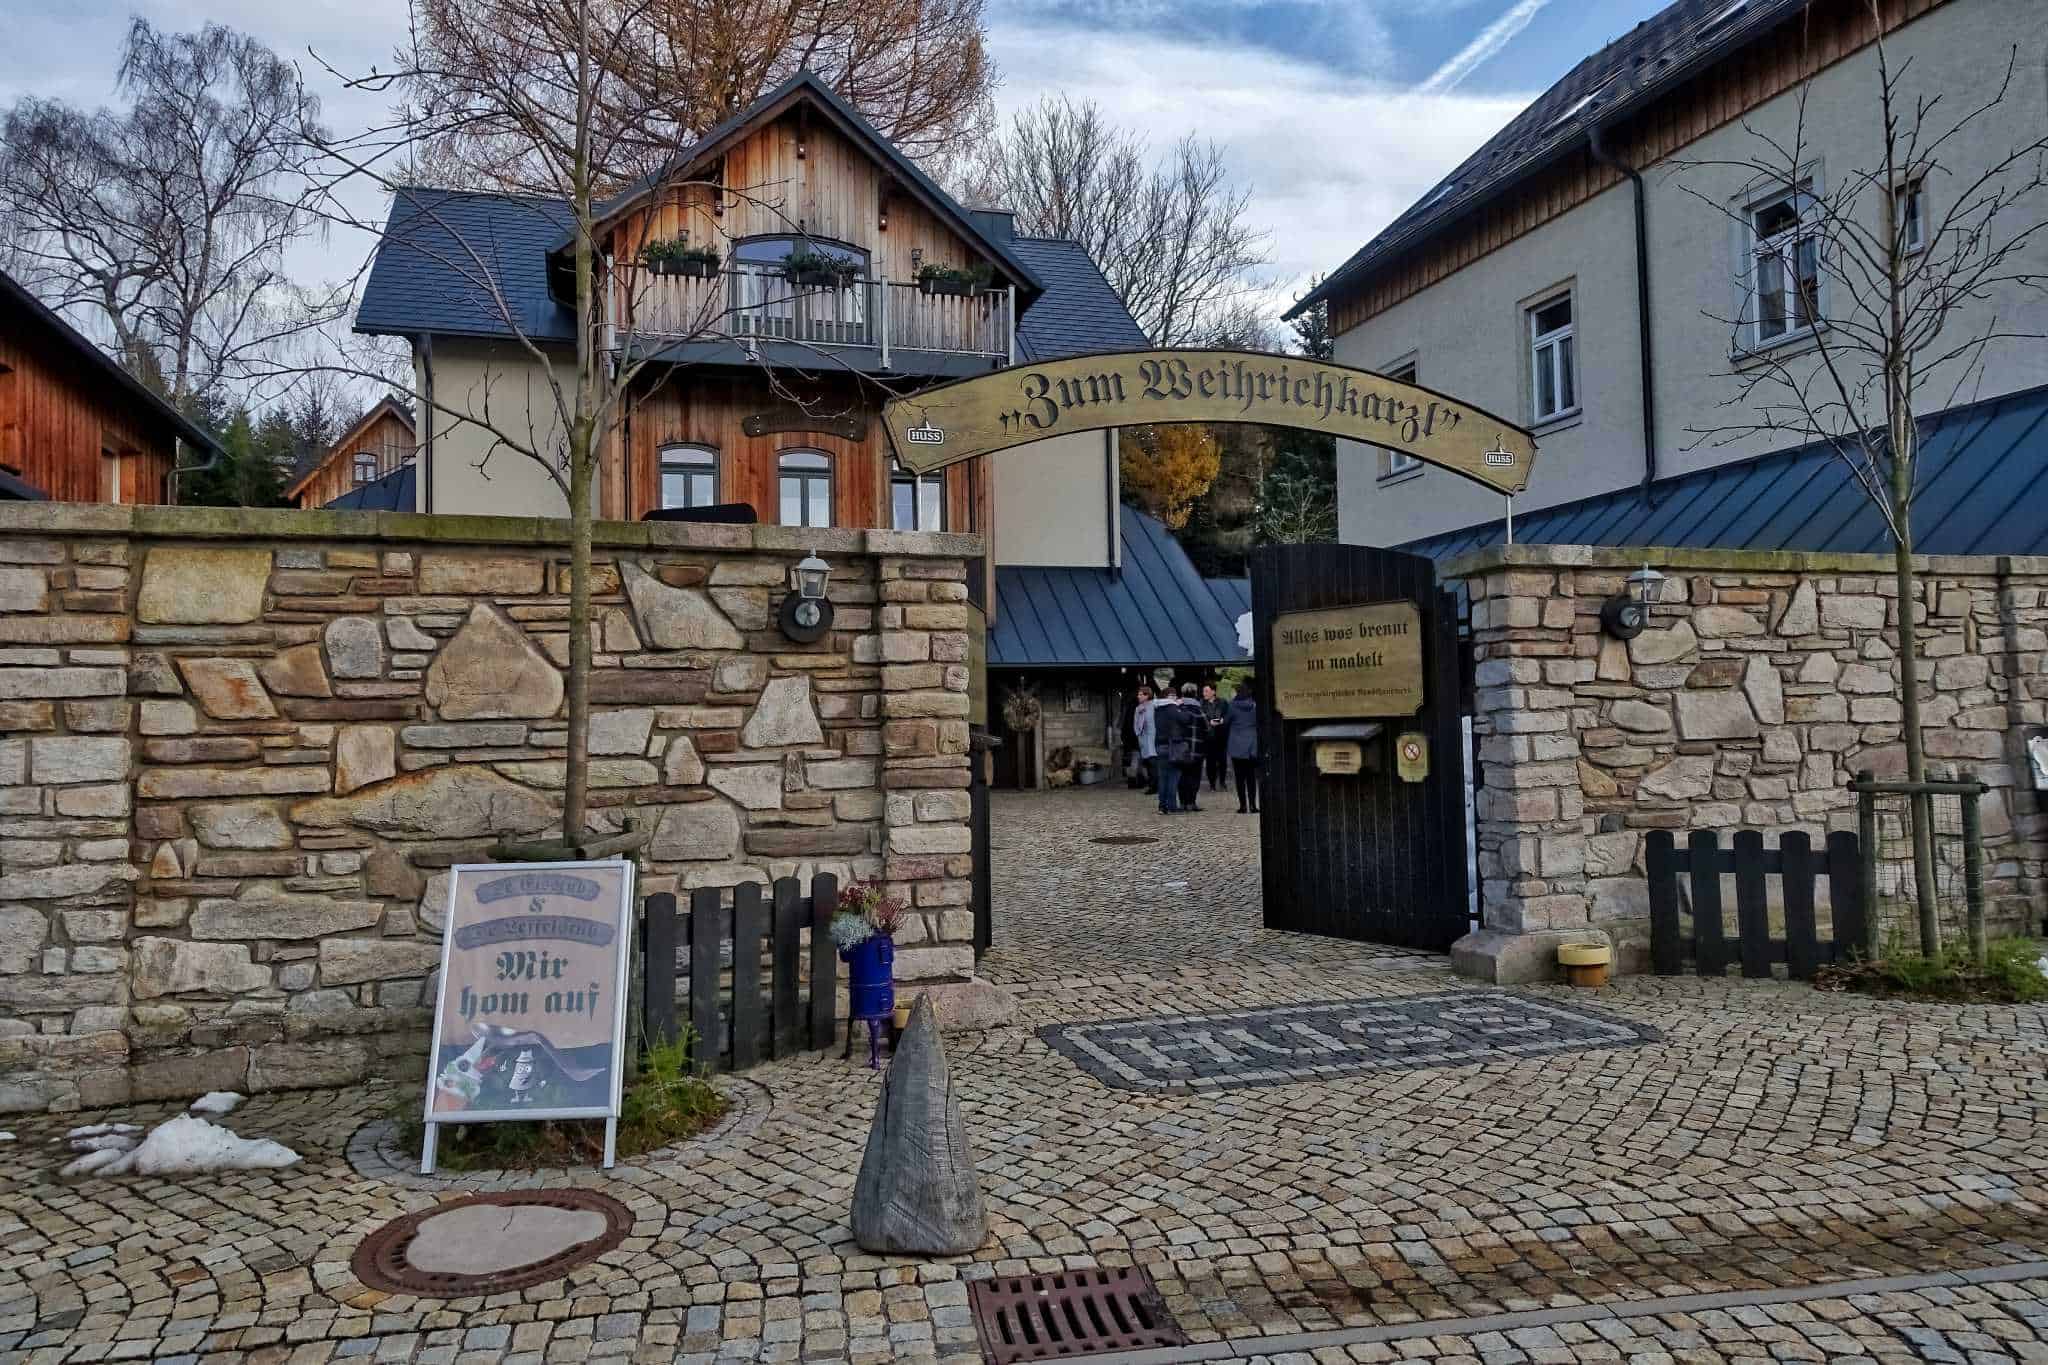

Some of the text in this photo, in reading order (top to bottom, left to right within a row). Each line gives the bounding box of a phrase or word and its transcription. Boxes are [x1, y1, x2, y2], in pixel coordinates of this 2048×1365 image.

[911, 431, 941, 441] HUSS
[1488, 454, 1512, 463] HUSS
[1281, 621, 1408, 645] Alles wos brennt
[1307, 658, 1325, 671] un
[496, 950, 568, 981] Mir
[457, 982, 600, 1024] hom auf
[1109, 1006, 1554, 1070] HUSS
